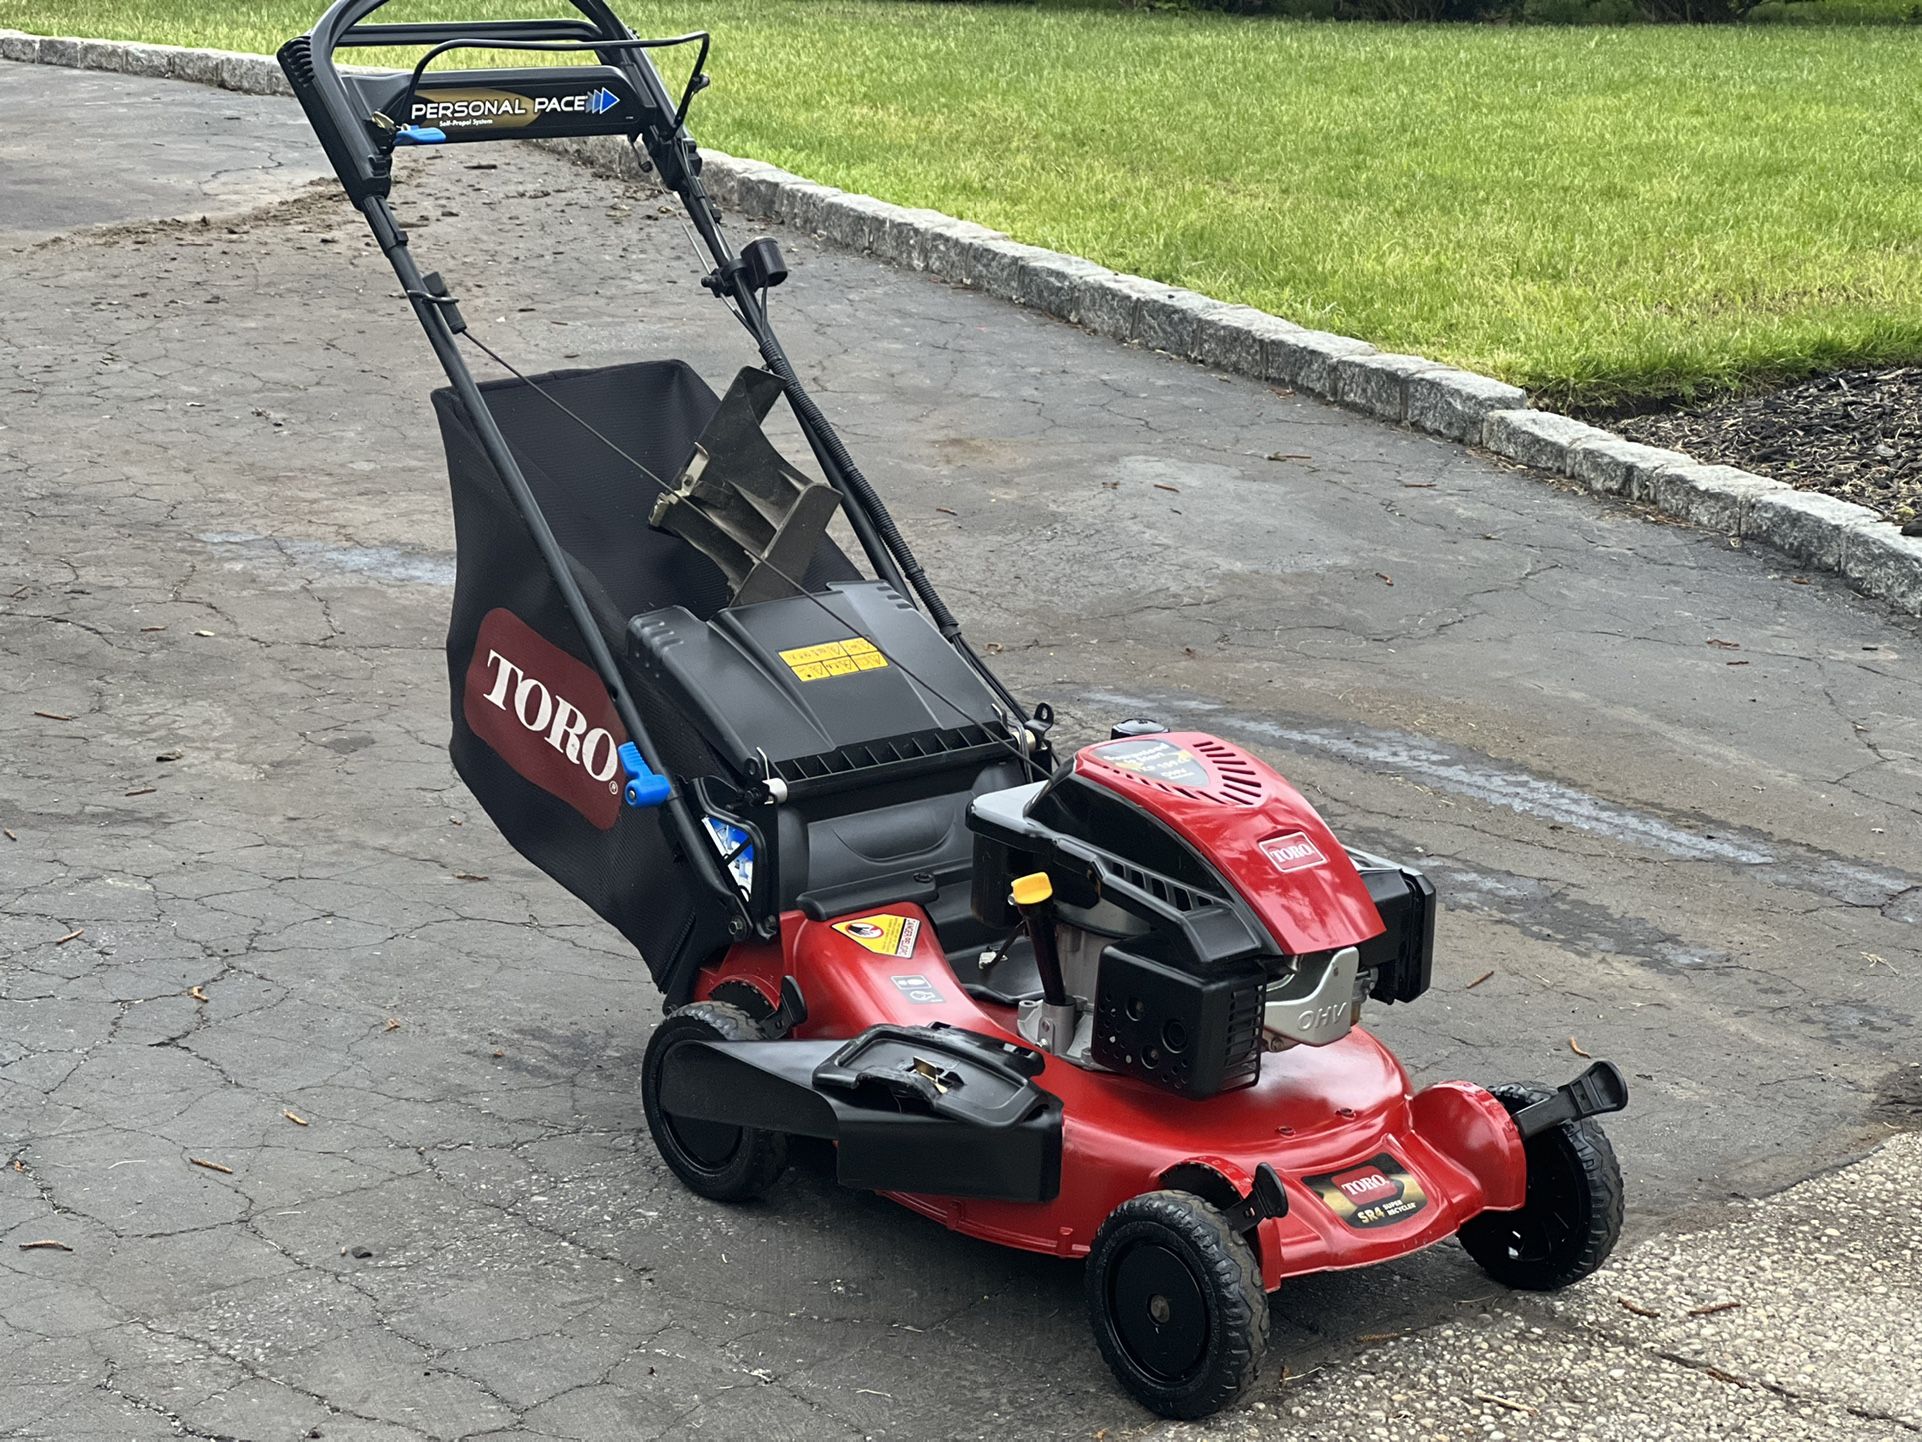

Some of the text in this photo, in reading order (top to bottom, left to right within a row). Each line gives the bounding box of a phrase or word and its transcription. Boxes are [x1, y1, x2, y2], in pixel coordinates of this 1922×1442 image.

[410, 95, 586, 119] PERSONAL PACE
[482, 649, 618, 782] TORO
[1269, 842, 1313, 863] TORO
[1297, 1002, 1347, 1031] OHV
[1341, 1174, 1389, 1196] TORO
[1357, 1200, 1403, 1223] SR4 SUPER
